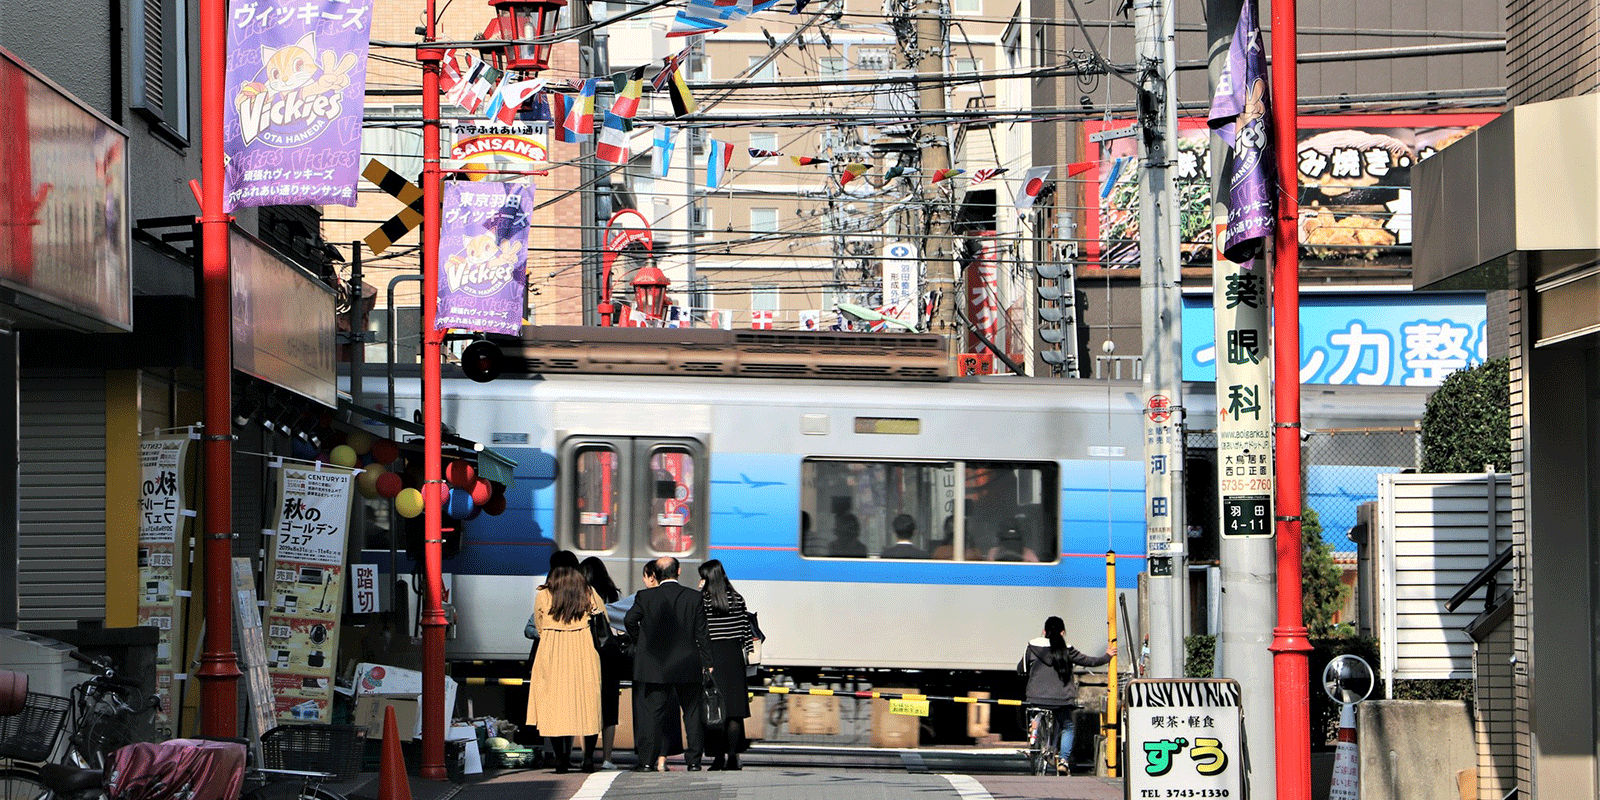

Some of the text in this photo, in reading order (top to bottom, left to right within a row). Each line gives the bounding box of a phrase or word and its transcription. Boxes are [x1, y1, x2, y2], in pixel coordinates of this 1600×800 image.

[234, 2, 368, 29] ヴィッキーズ
[241, 91, 341, 144] Vickies
[263, 132, 283, 143] OTA
[286, 119, 325, 143] HANEDA
[455, 124, 543, 135] 穴守ふれあい通り
[243, 168, 335, 182] 頑張れヴィッキーズ
[459, 191, 521, 209] 東京羽田
[445, 208, 530, 227] ヴィッキーズ
[448, 263, 513, 292] Vickies
[463, 286, 477, 295] OTA
[1225, 272, 1261, 421] 葵眼科
[1225, 454, 1267, 464] 大鳥居駅
[1225, 465, 1267, 476] 西口正面
[308, 474, 339, 482] CENTURY
[1221, 478, 1271, 491] 5735-2760
[1151, 454, 1168, 516] 河田
[283, 498, 321, 521] 秋の
[1230, 505, 1264, 516] 羽田
[281, 520, 338, 535] ゴールデン
[1231, 518, 1263, 530] 4-11
[280, 533, 312, 546] フェア
[276, 570, 296, 582] 売買
[357, 568, 375, 613] 踏切
[271, 625, 289, 637] 賃貸
[1152, 715, 1215, 728] 喫茶・軽食
[1144, 737, 1229, 776] ずう
[1141, 789, 1230, 799] TEL 3743-1330
